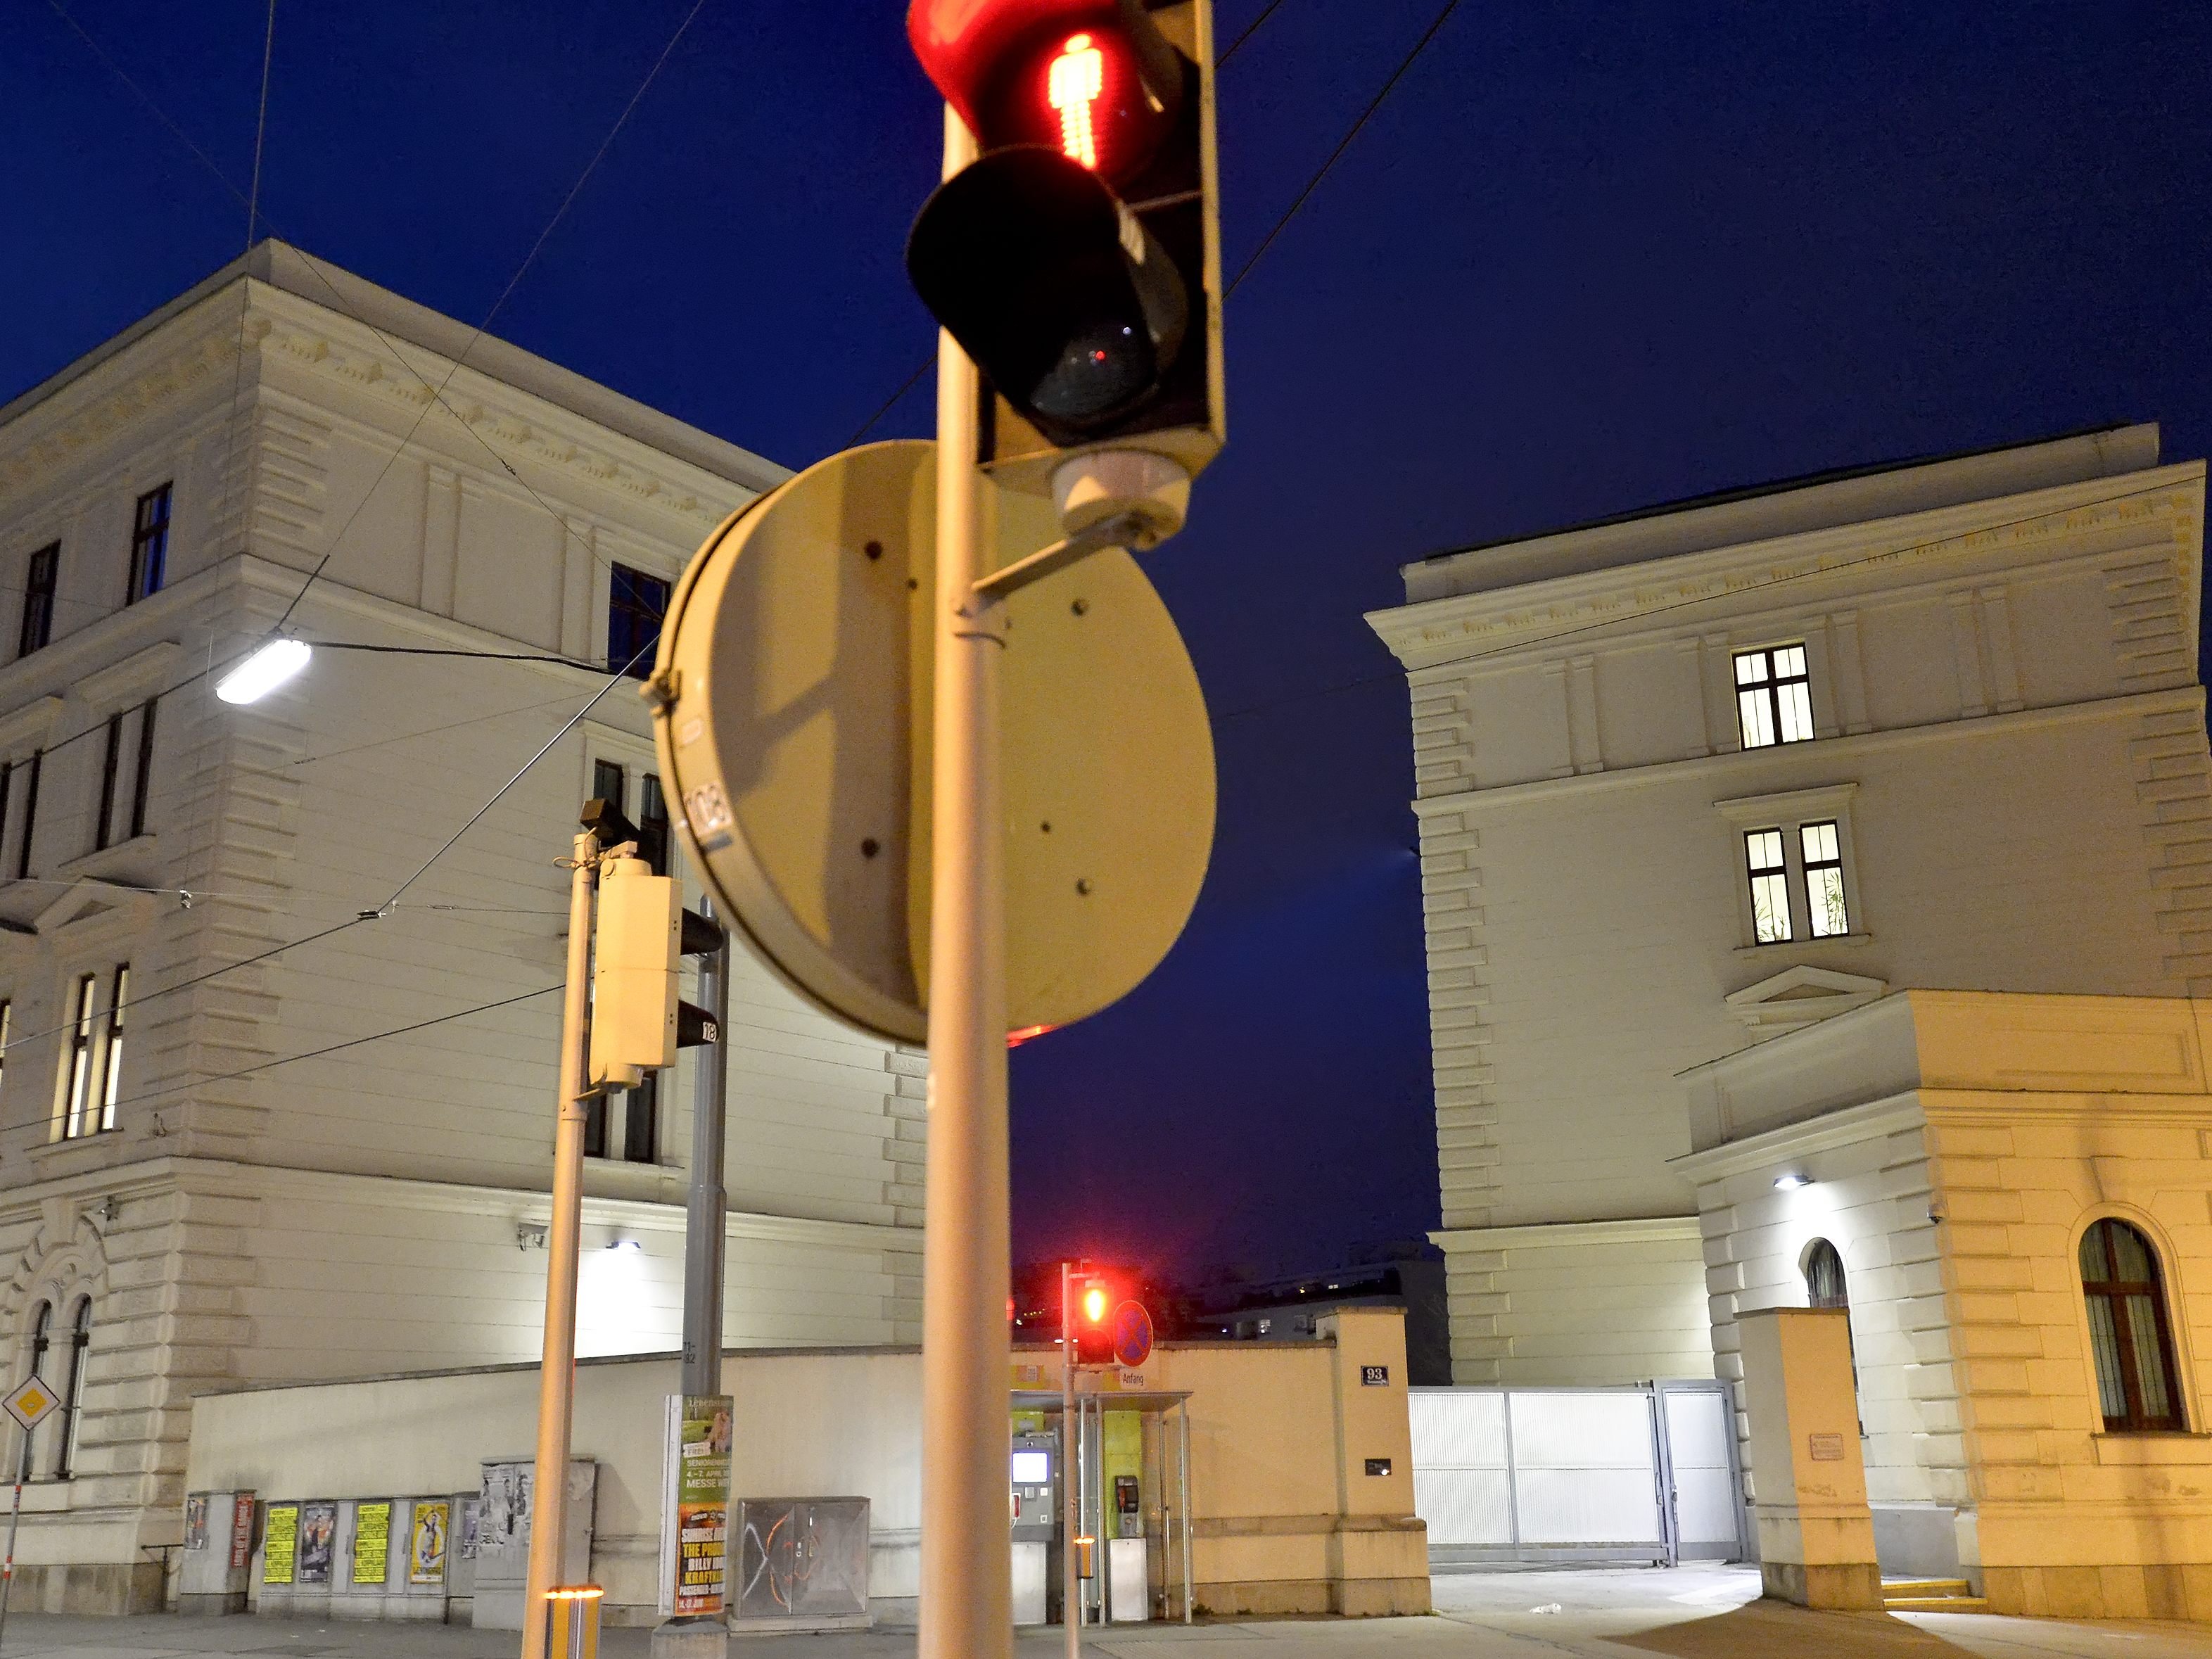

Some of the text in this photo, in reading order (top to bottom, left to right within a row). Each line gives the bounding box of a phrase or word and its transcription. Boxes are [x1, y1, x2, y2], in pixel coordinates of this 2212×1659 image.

[704, 1023, 716, 1040] 18
[1123, 1373, 1144, 1386] Anfang
[1366, 1368, 1382, 1380] 93
[686, 1479, 716, 1488] MESSE
[683, 1544, 700, 1558] THE
